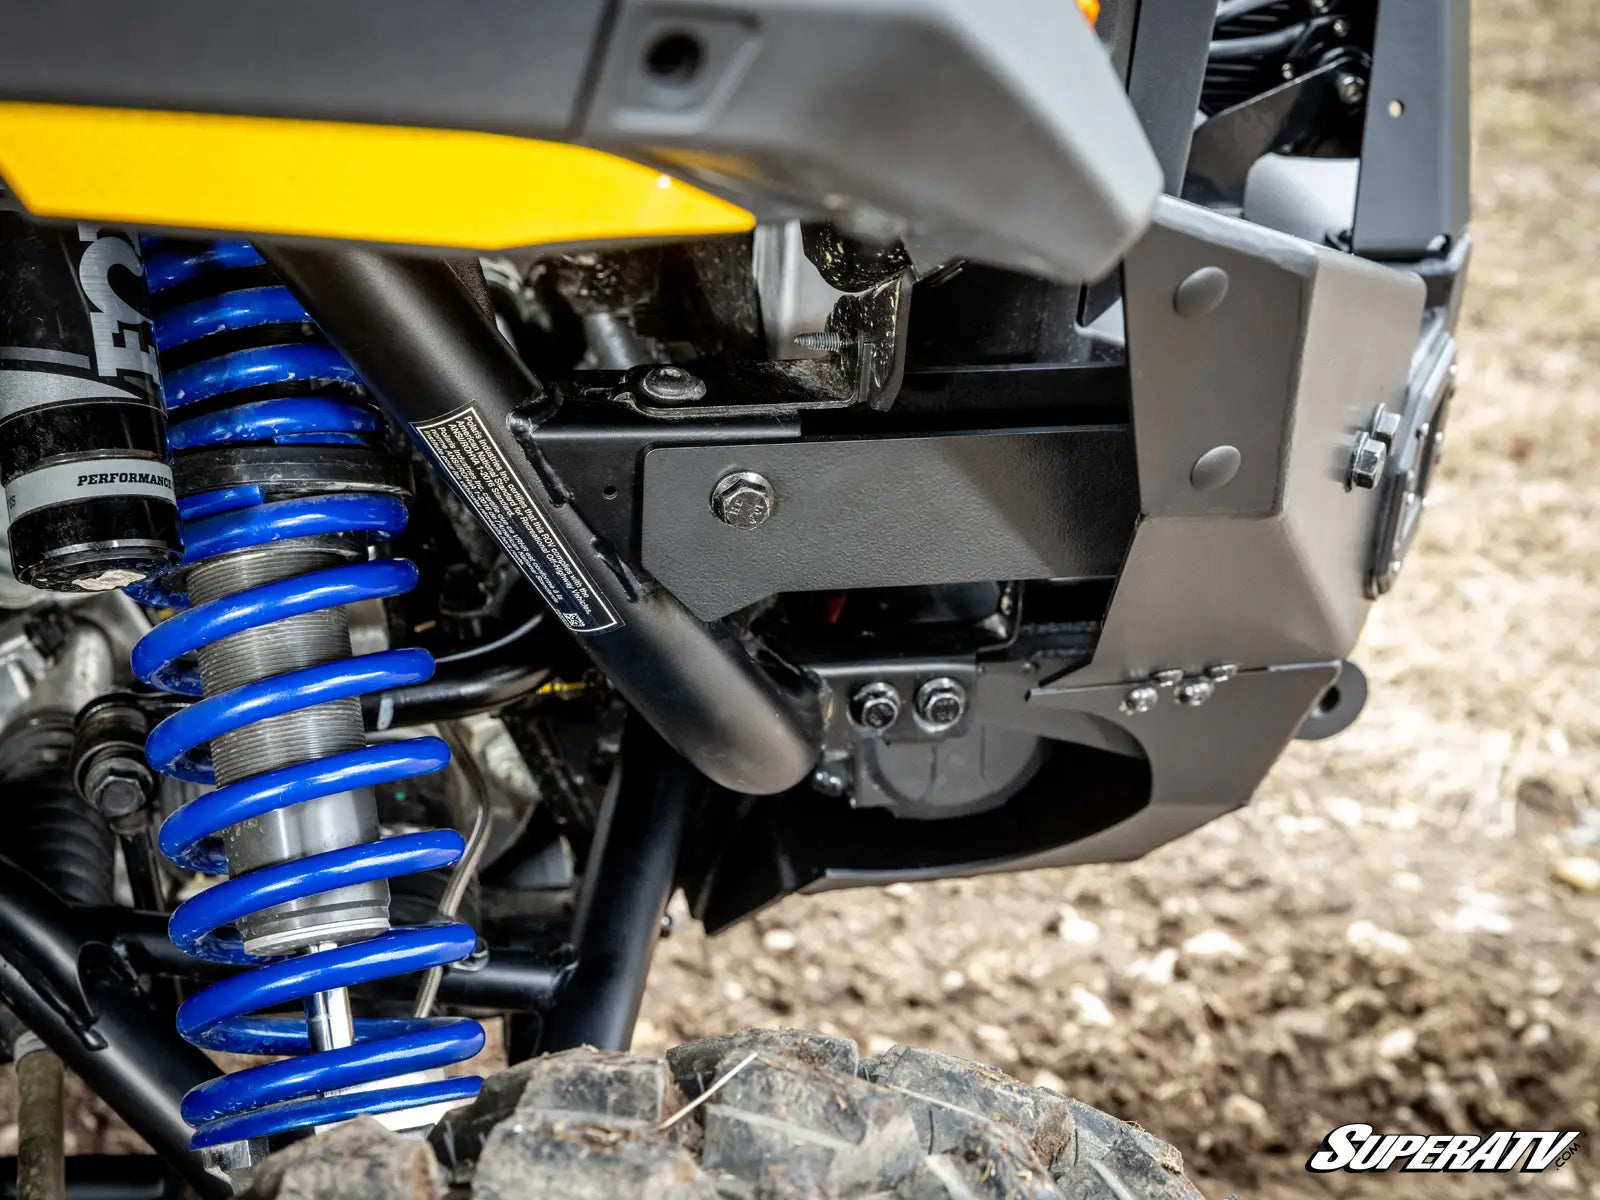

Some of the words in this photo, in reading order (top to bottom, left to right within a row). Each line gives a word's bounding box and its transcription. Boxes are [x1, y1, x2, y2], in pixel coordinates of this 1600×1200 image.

[78, 223, 160, 386] FO
[437, 426, 457, 448] Polaris
[452, 449, 478, 479] Industries
[473, 480, 485, 491] Inc.
[447, 423, 480, 464] ANSI/ROHVA
[476, 466, 495, 487] 1-2016
[455, 420, 481, 450] American
[475, 451, 499, 477] National
[493, 478, 518, 506] Standard
[512, 506, 524, 515] for
[519, 516, 550, 553] Recreational
[544, 553, 575, 589] Off-Highway
[462, 416, 484, 439] Polaris
[477, 439, 504, 469] Industries
[498, 471, 512, 482] Inc.
[507, 483, 529, 508] certifies
[524, 509, 537, 520] that
[532, 521, 545, 532] this
[540, 533, 555, 548] ROV
[549, 547, 573, 574] complies
[569, 574, 583, 586] with
[578, 587, 590, 597] the
